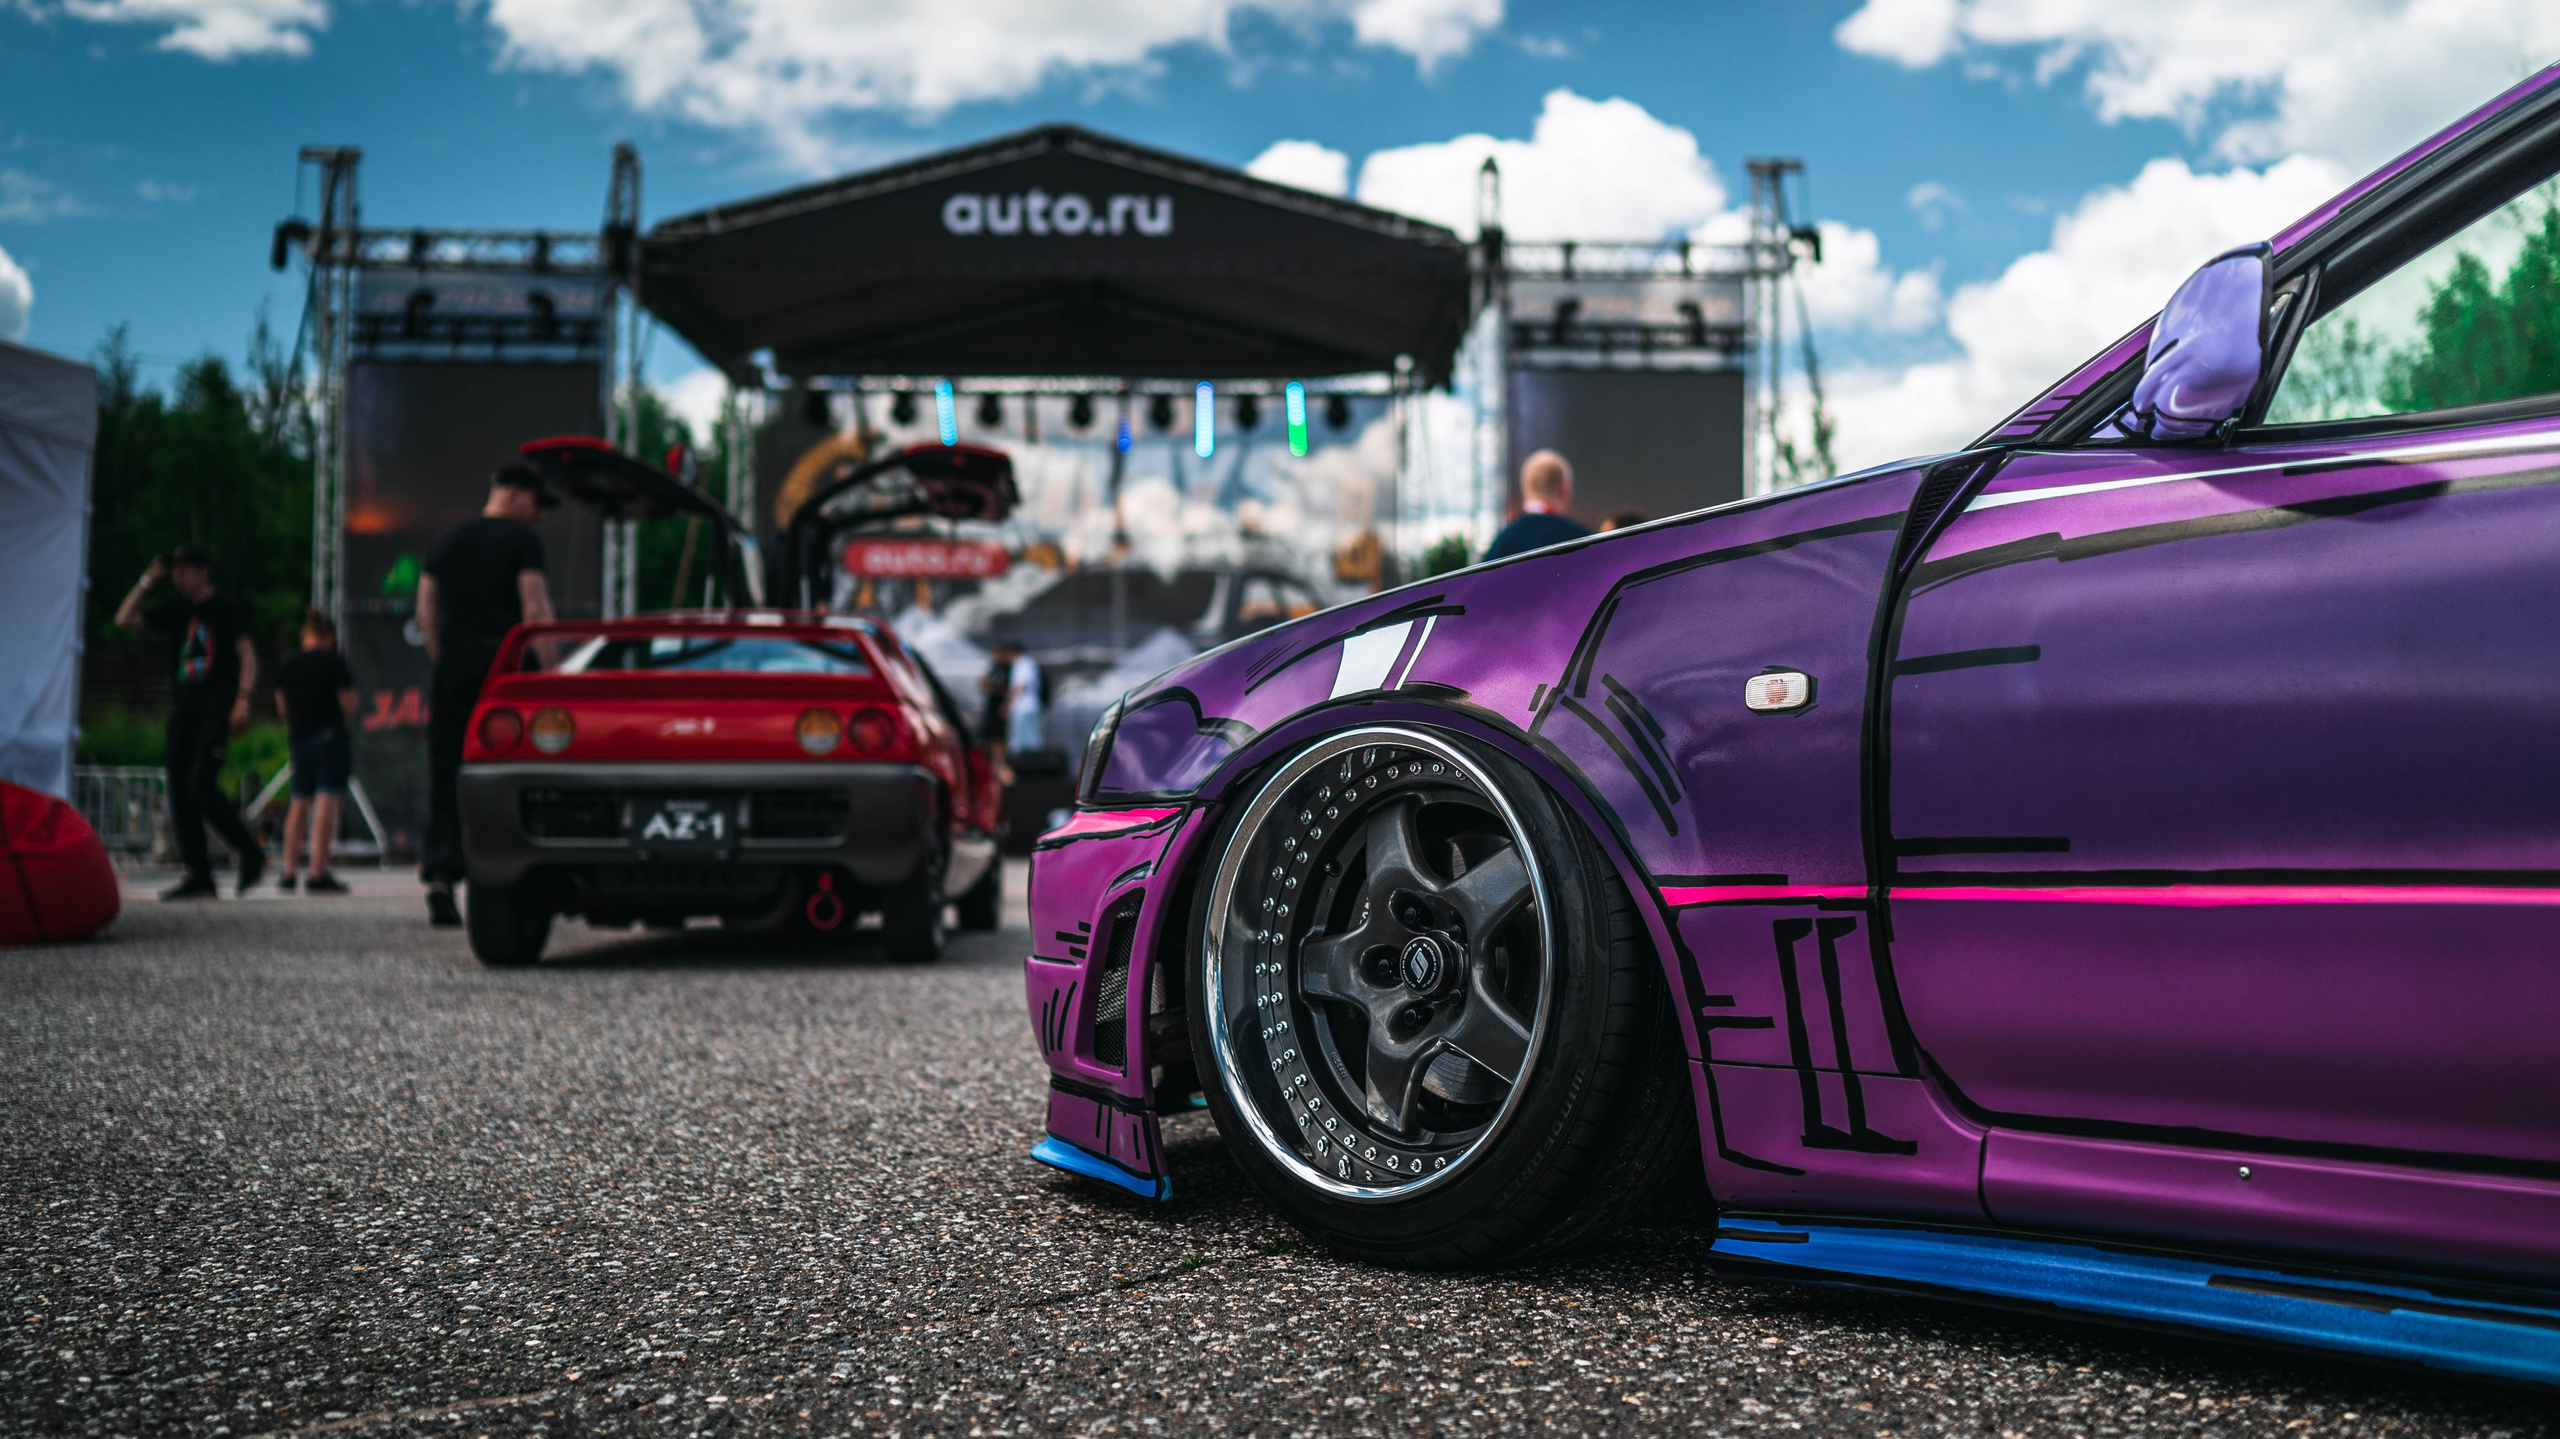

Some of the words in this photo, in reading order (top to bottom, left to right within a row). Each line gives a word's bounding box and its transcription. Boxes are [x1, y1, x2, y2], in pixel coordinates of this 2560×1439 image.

[943, 187, 1172, 236] auto.ru
[863, 544, 990, 576] auto.ru
[1497, 1068, 1587, 1209] WINDFORCE
